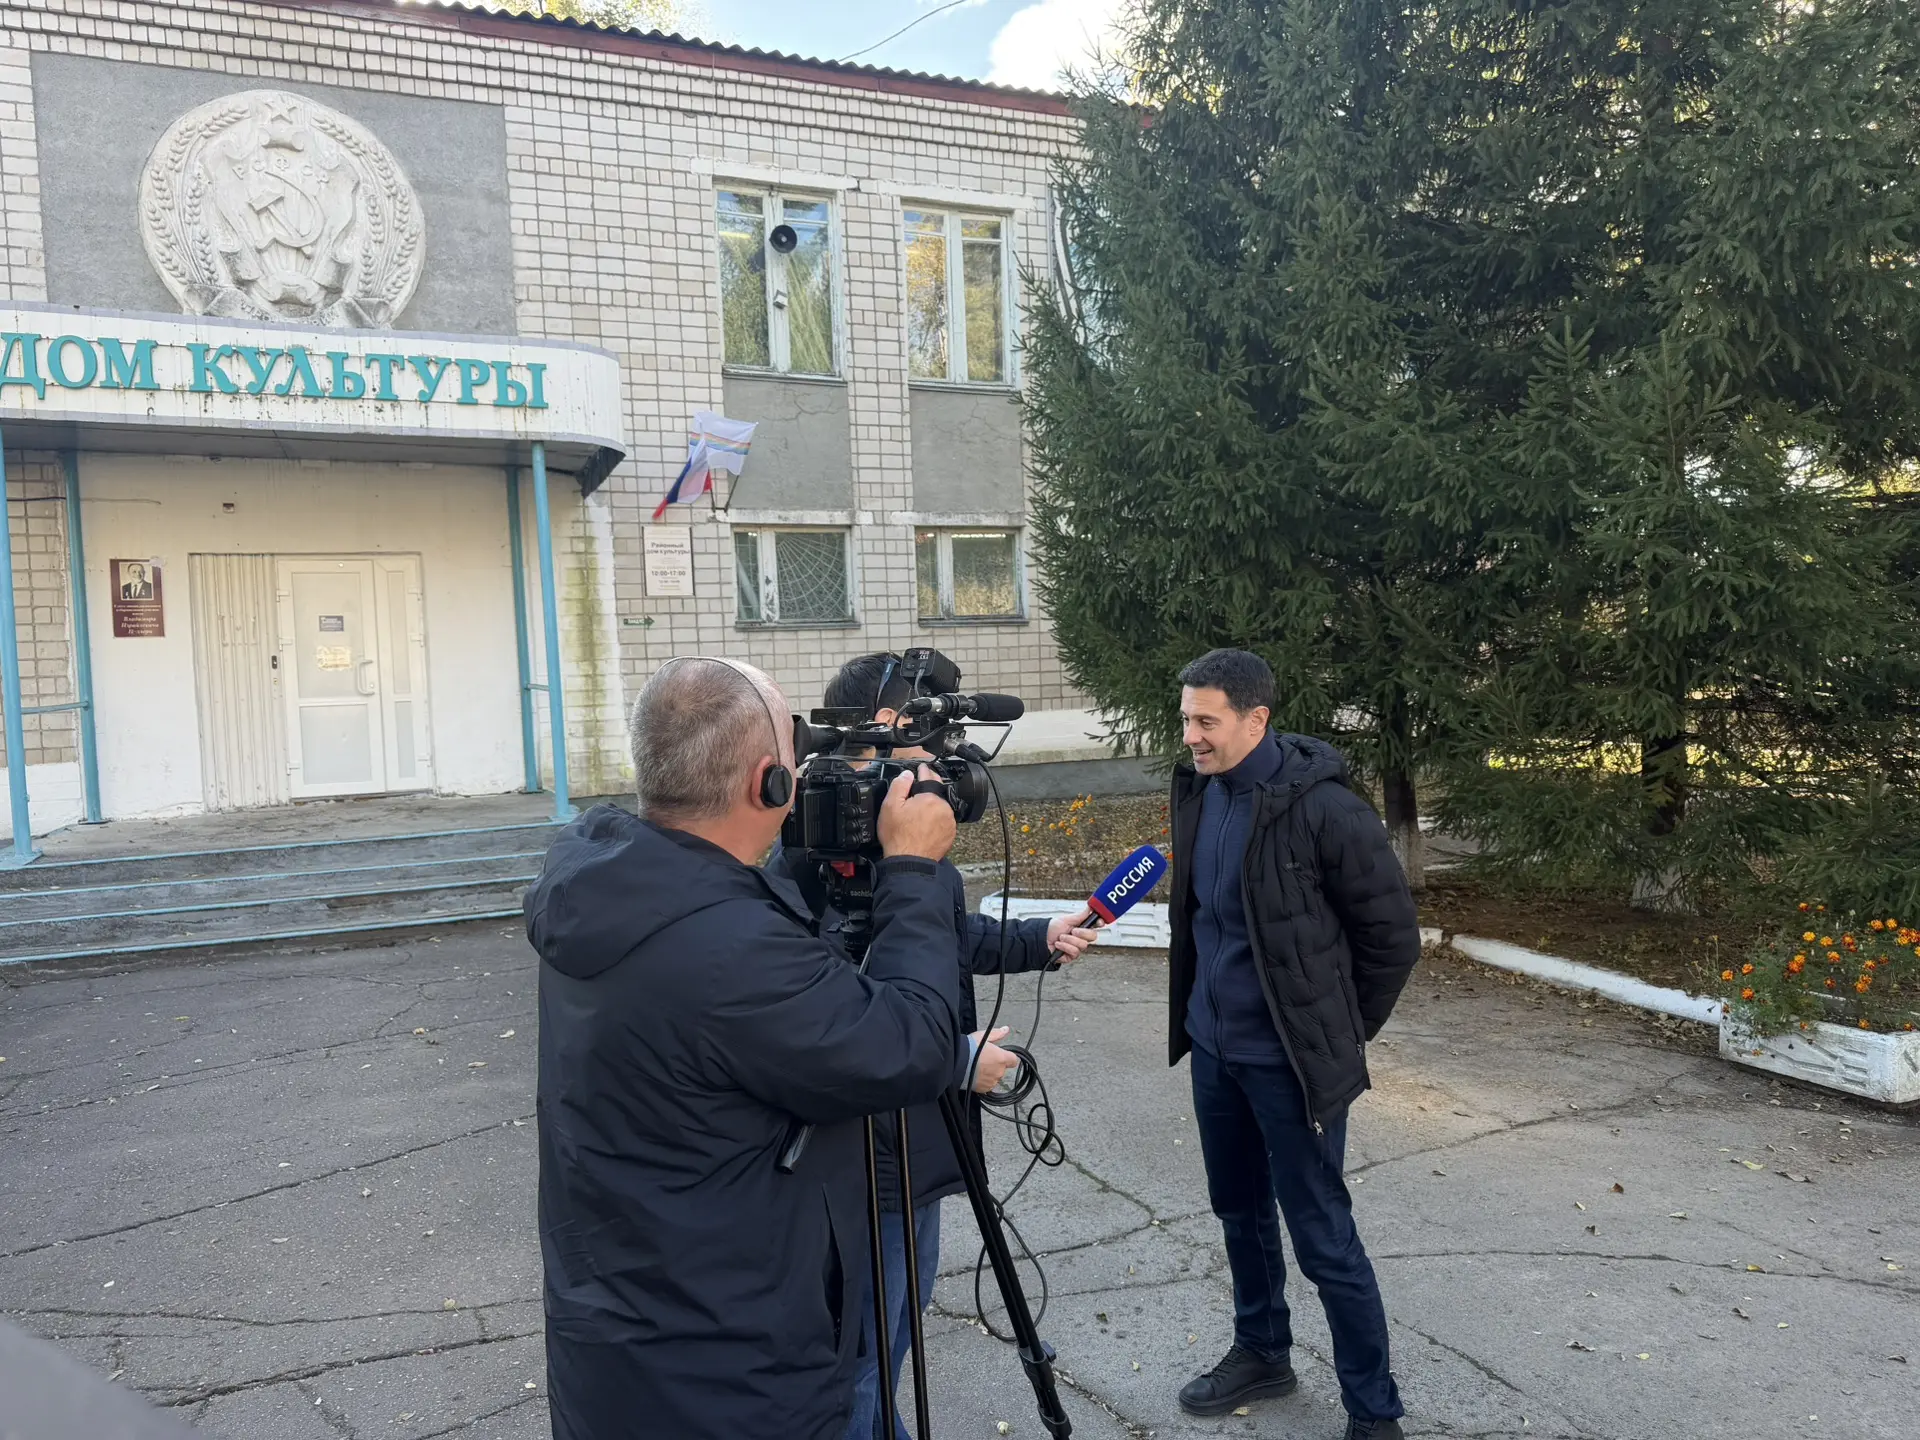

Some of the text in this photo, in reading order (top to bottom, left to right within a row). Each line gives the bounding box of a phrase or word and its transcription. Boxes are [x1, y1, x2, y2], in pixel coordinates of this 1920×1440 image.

[0, 332, 549, 409] ДОМ КУЛЬТУРЫ
[1107, 856, 1155, 905] РОССИЯ
